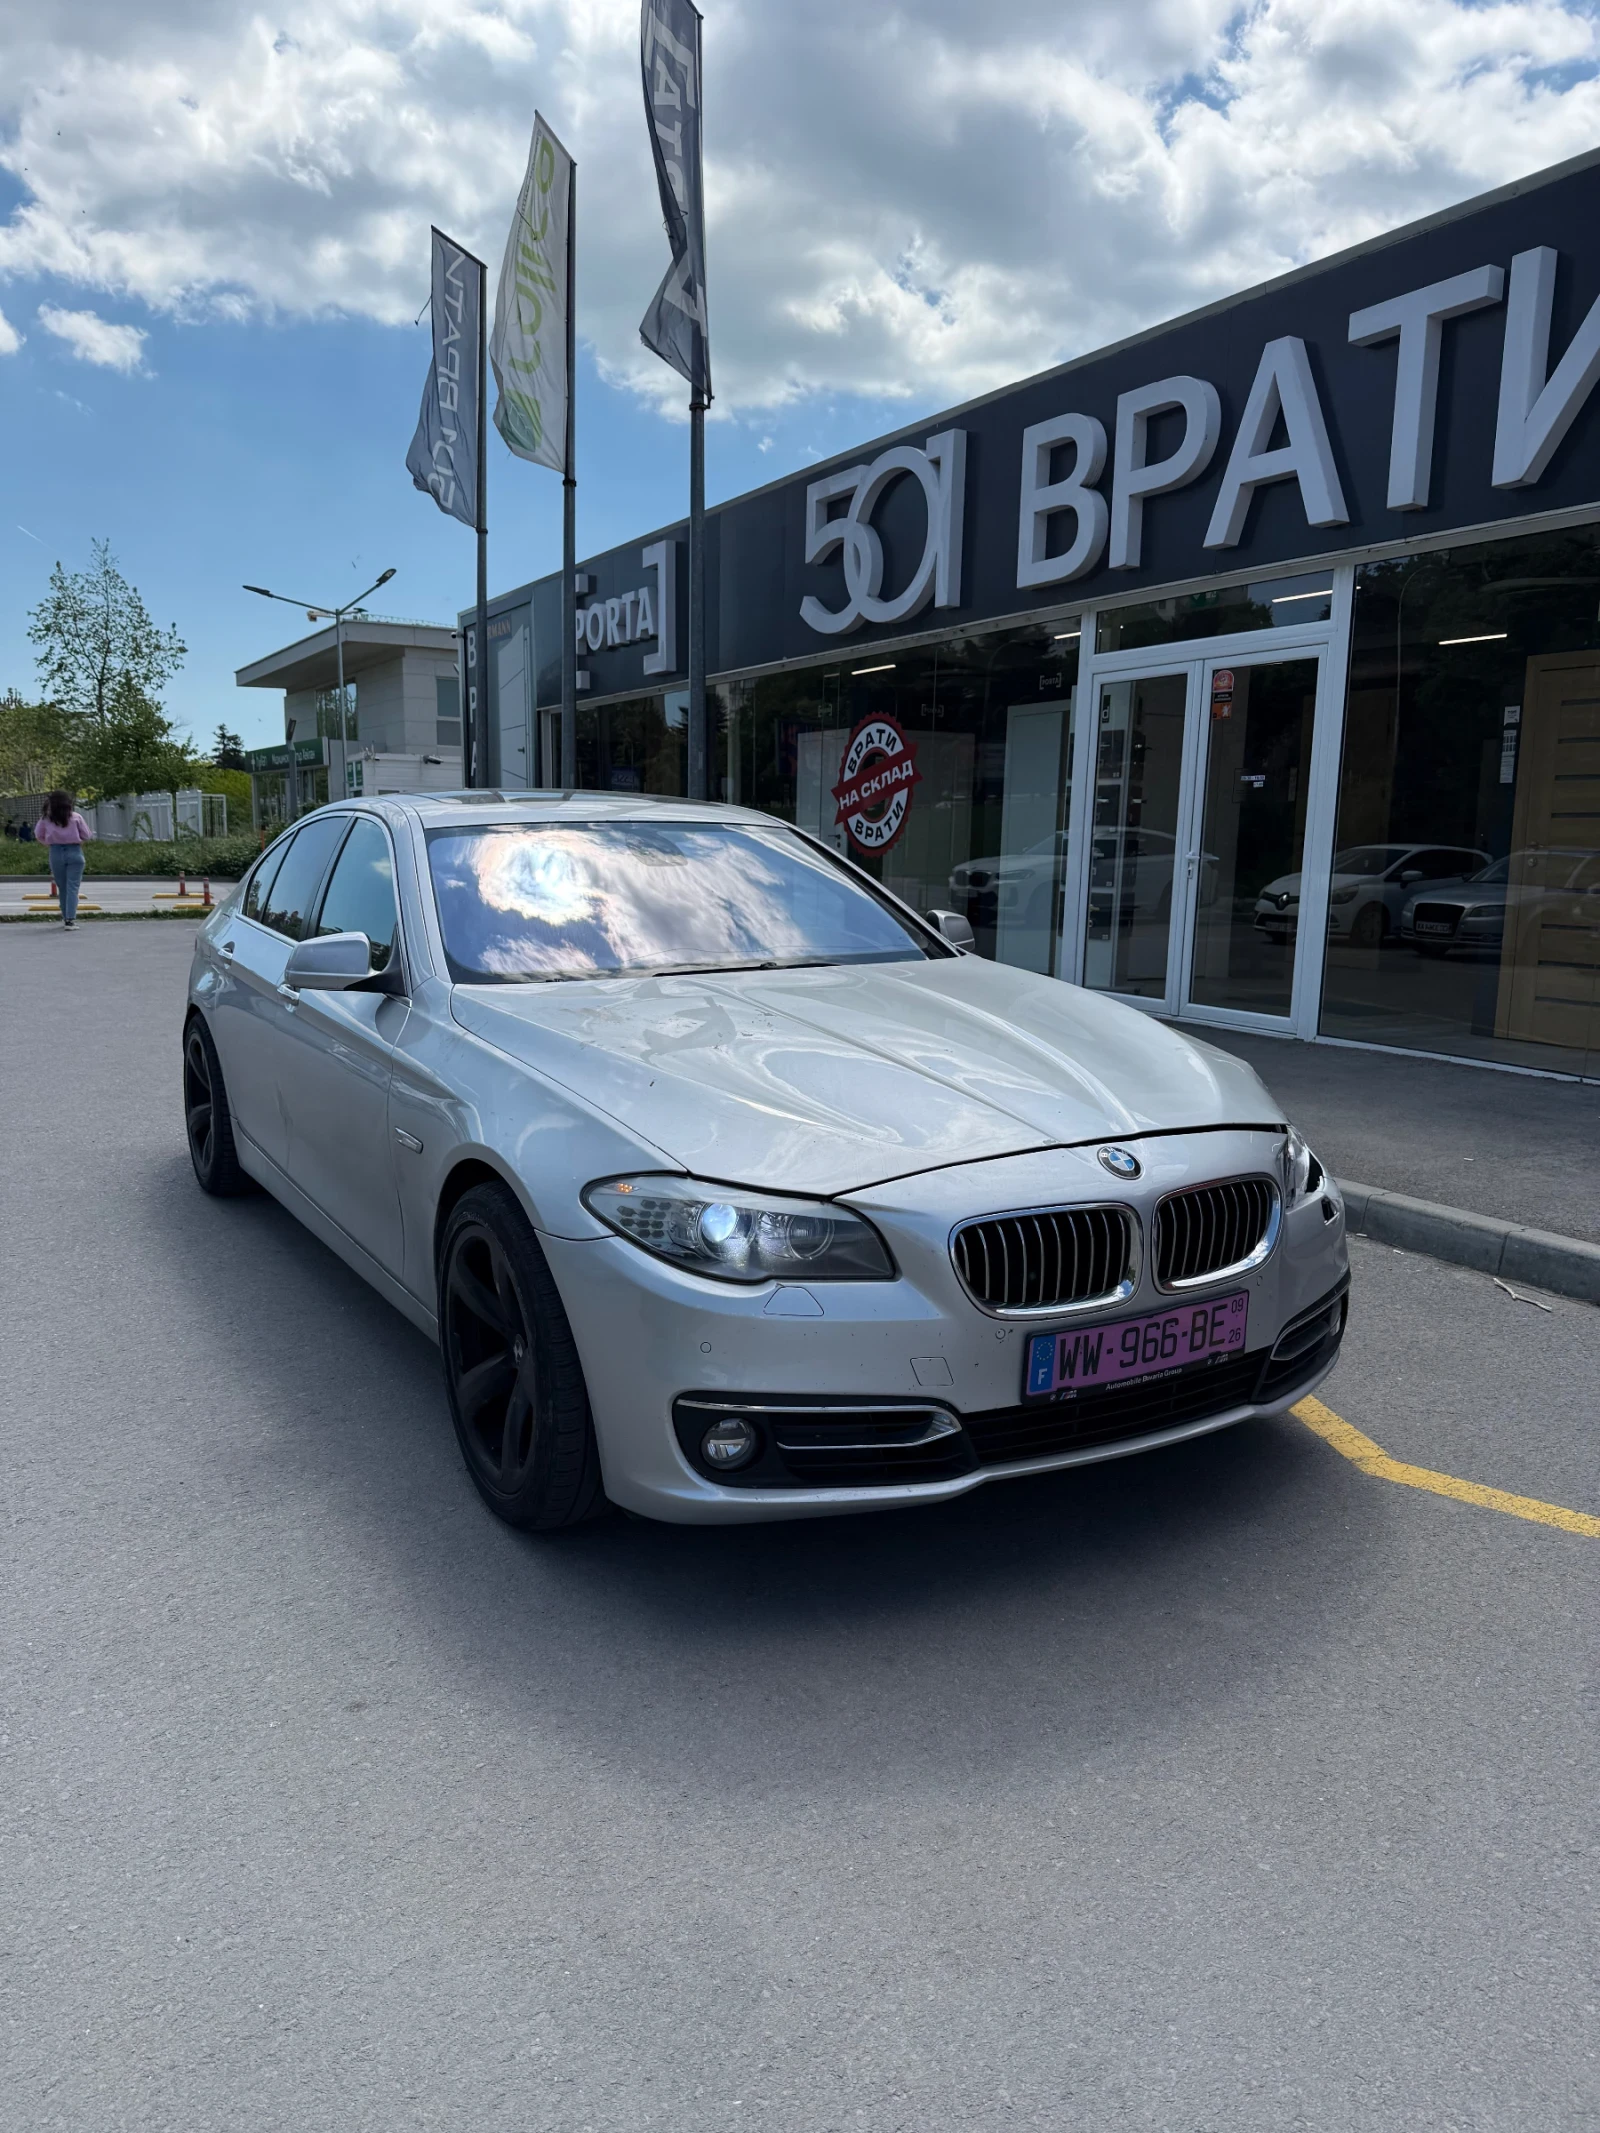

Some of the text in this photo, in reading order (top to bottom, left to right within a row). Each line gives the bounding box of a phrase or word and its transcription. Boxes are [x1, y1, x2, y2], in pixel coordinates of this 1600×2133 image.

[800, 428, 967, 635] 501
[847, 728, 897, 775] ВРАТИ
[839, 759, 914, 810] НА СКЛАД
[854, 800, 904, 842] ВРАТИ
[1231, 1298, 1244, 1314] 09
[1228, 1327, 1241, 1344] 26
[1037, 1368, 1048, 1385] F
[1105, 1376, 1142, 1391] Automobile
[1164, 1367, 1183, 1378] Group
